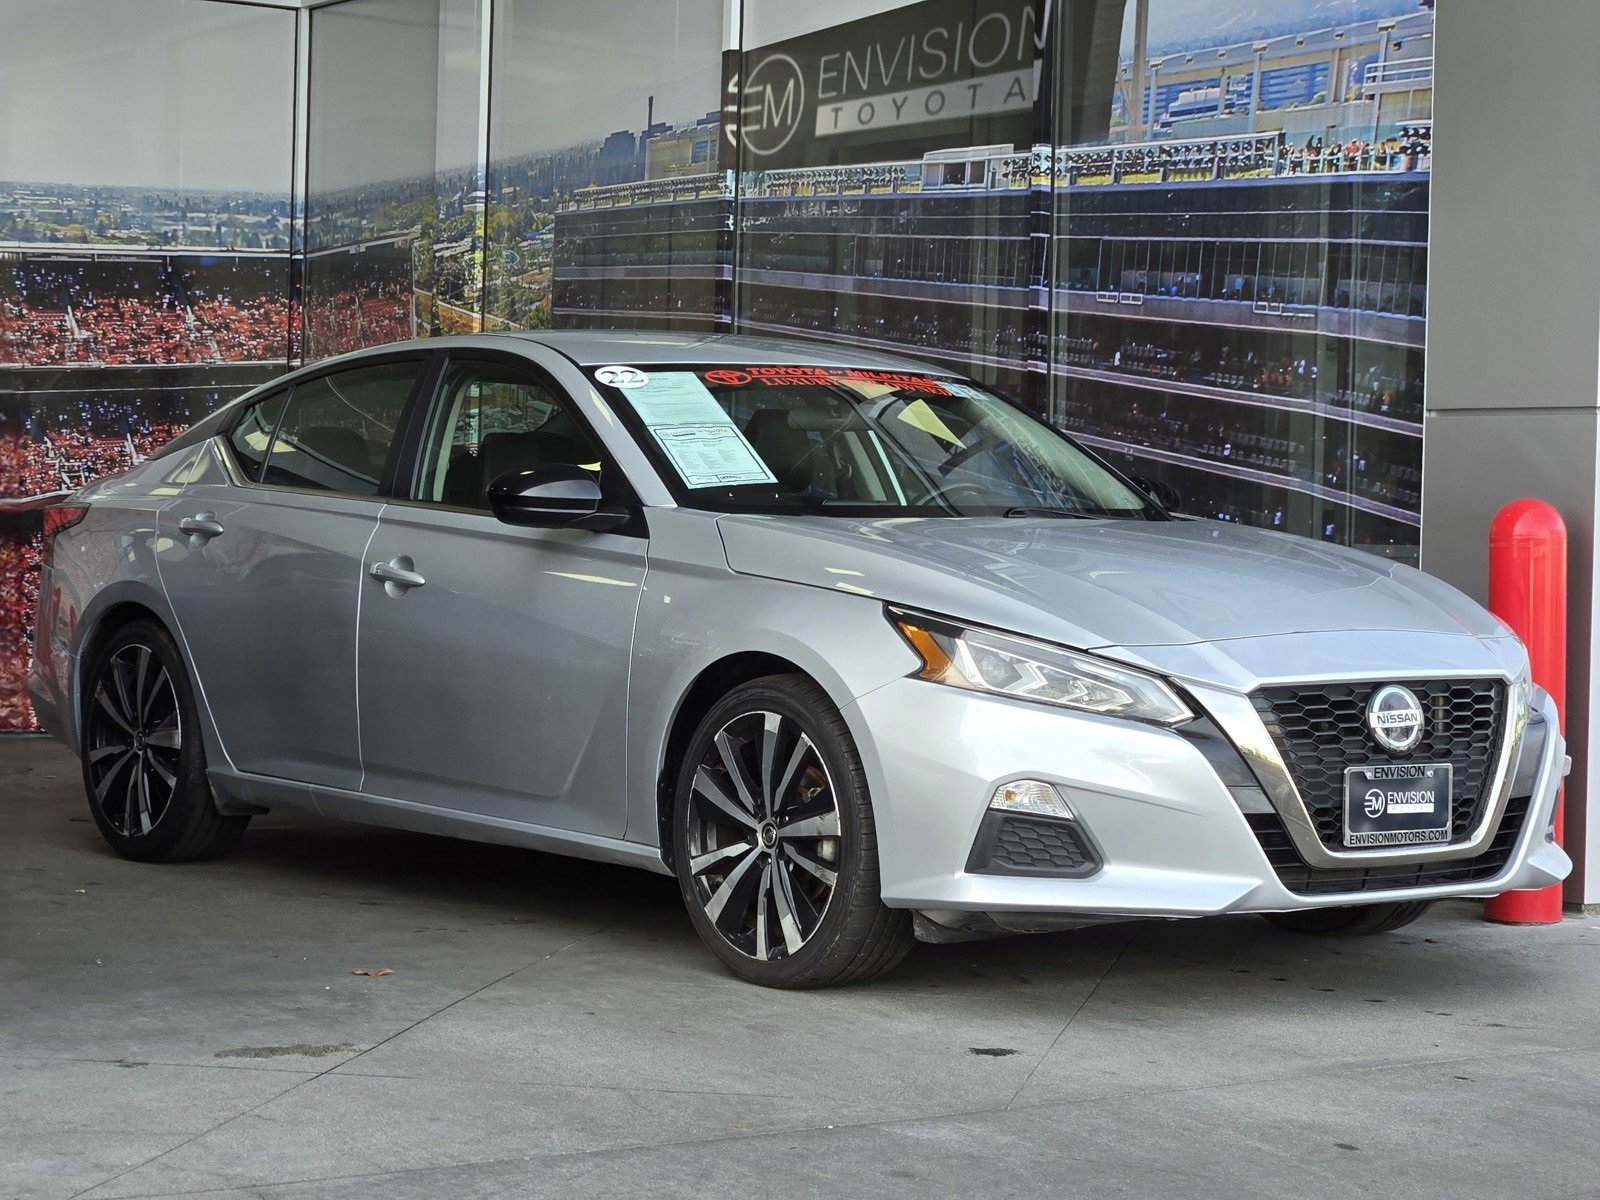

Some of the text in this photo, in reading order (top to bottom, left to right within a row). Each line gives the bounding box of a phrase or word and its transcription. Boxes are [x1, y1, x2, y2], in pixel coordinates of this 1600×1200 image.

[818, 0, 1051, 99] ENVISION
[830, 76, 1026, 129] TOYOTA
[600, 370, 644, 384] 22
[746, 367, 831, 376] TOYOTA
[847, 369, 936, 386] MILPITAS
[1376, 712, 1418, 725] NISSAN
[1374, 766, 1425, 779] ENVISION
[1387, 790, 1435, 804] ENVISION
[1350, 829, 1448, 846] ENVISIONMOTORS.COM
